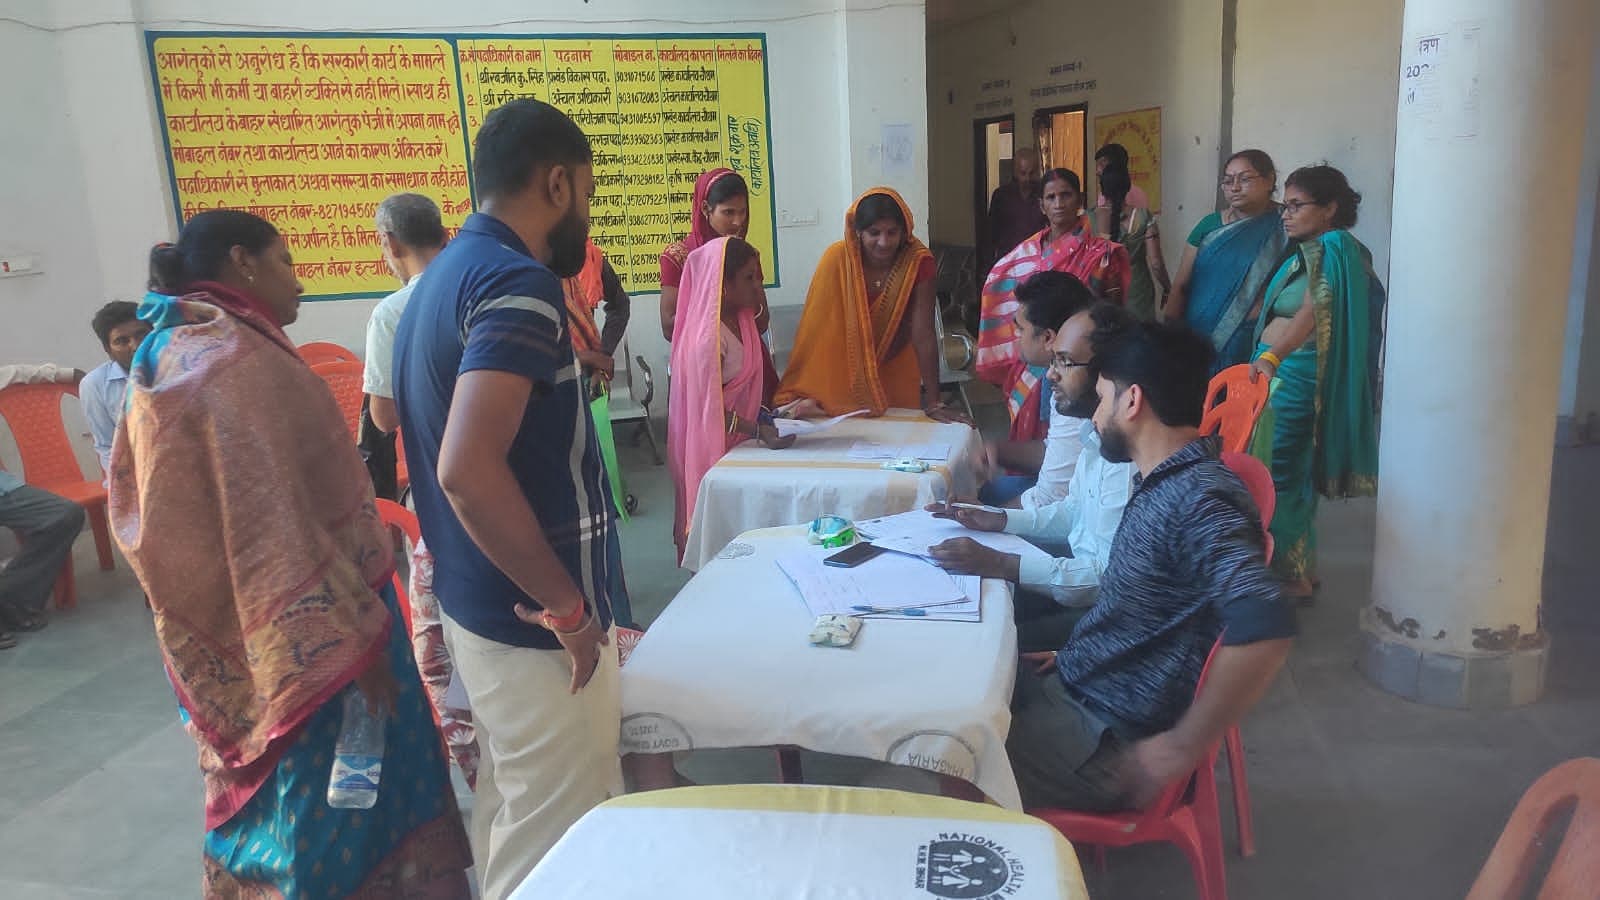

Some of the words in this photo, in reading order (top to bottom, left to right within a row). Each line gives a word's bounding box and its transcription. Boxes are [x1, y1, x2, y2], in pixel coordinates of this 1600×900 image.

[218, 44, 232, 70] से
[236, 46, 285, 75] अनुरोध
[286, 43, 300, 72] है
[302, 44, 320, 70] कि
[322, 45, 369, 71] सरकारी
[372, 45, 396, 70] कार्य
[398, 44, 411, 70] के
[412, 44, 446, 72] मामले
[525, 50, 541, 62] नाम
[175, 74, 207, 101] किसी
[209, 77, 224, 101] भी
[253, 83, 268, 101] या
[271, 77, 303, 101] बाहरी
[304, 76, 340, 100] व्यक्ति
[340, 76, 353, 101] से
[437, 77, 450, 100] ही
[167, 108, 224, 132] कार्यालय
[226, 107, 239, 132] के
[238, 114, 265, 133] बाहर
[267, 109, 314, 133] संधारित
[315, 110, 361, 136] आगंतुक
[361, 107, 384, 131] पंजी
[396, 113, 425, 131] अपना
[426, 113, 446, 130] नाम
[172, 139, 217, 163] मोबाइल
[218, 141, 242, 163] नंबर
[243, 145, 266, 162] तथा
[267, 137, 320, 162] कार्यालय
[320, 137, 344, 161] आने
[346, 143, 359, 160] का
[360, 143, 391, 162] कारण
[392, 137, 425, 161] अंकित
[176, 170, 235, 193] पदाधिकारी
[236, 170, 249, 192] से
[249, 174, 297, 196] मुलाकात
[298, 173, 330, 191] अथवा
[331, 173, 369, 192] समस्या
[370, 173, 385, 189] का
[385, 171, 429, 192] समाधान
[290, 227, 301, 250] से
[302, 227, 329, 249] अपील
[328, 223, 340, 250] है
[341, 225, 355, 248] कि
[327, 256, 352, 280] नंबर
[938, 832, 1010, 858] NATIONAL
